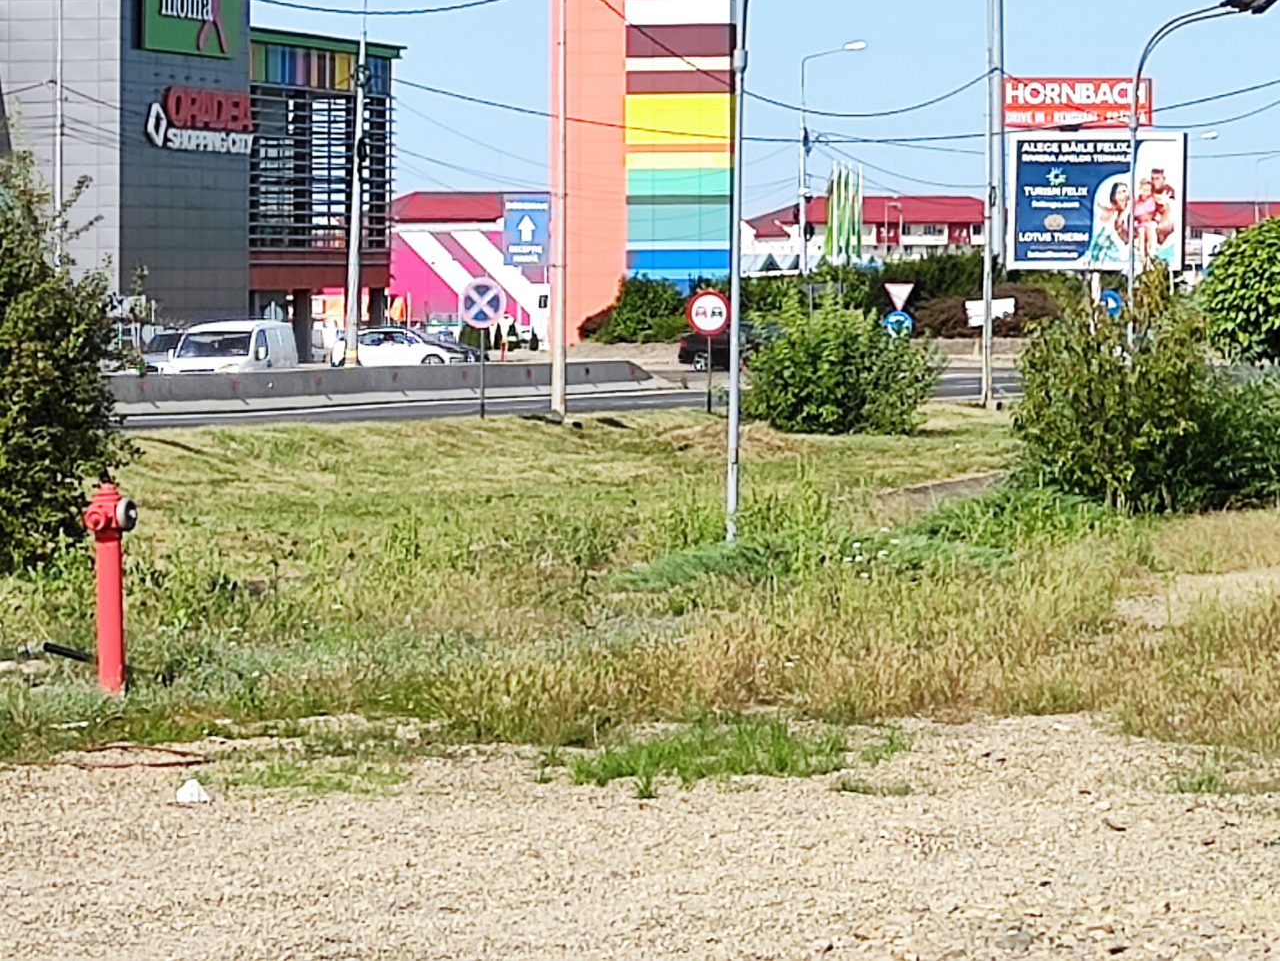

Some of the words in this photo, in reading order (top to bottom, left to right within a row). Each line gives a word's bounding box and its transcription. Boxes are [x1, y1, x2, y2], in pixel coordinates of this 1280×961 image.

[1005, 81, 1146, 105] HORNBACH
[167, 86, 254, 132] ORADEA
[166, 127, 228, 154] SHOPPING
[228, 132, 255, 156] CITY
[1022, 141, 1059, 153] ALEGE
[1062, 186, 1088, 196] FELIX
[1018, 231, 1052, 242] LOTUS
